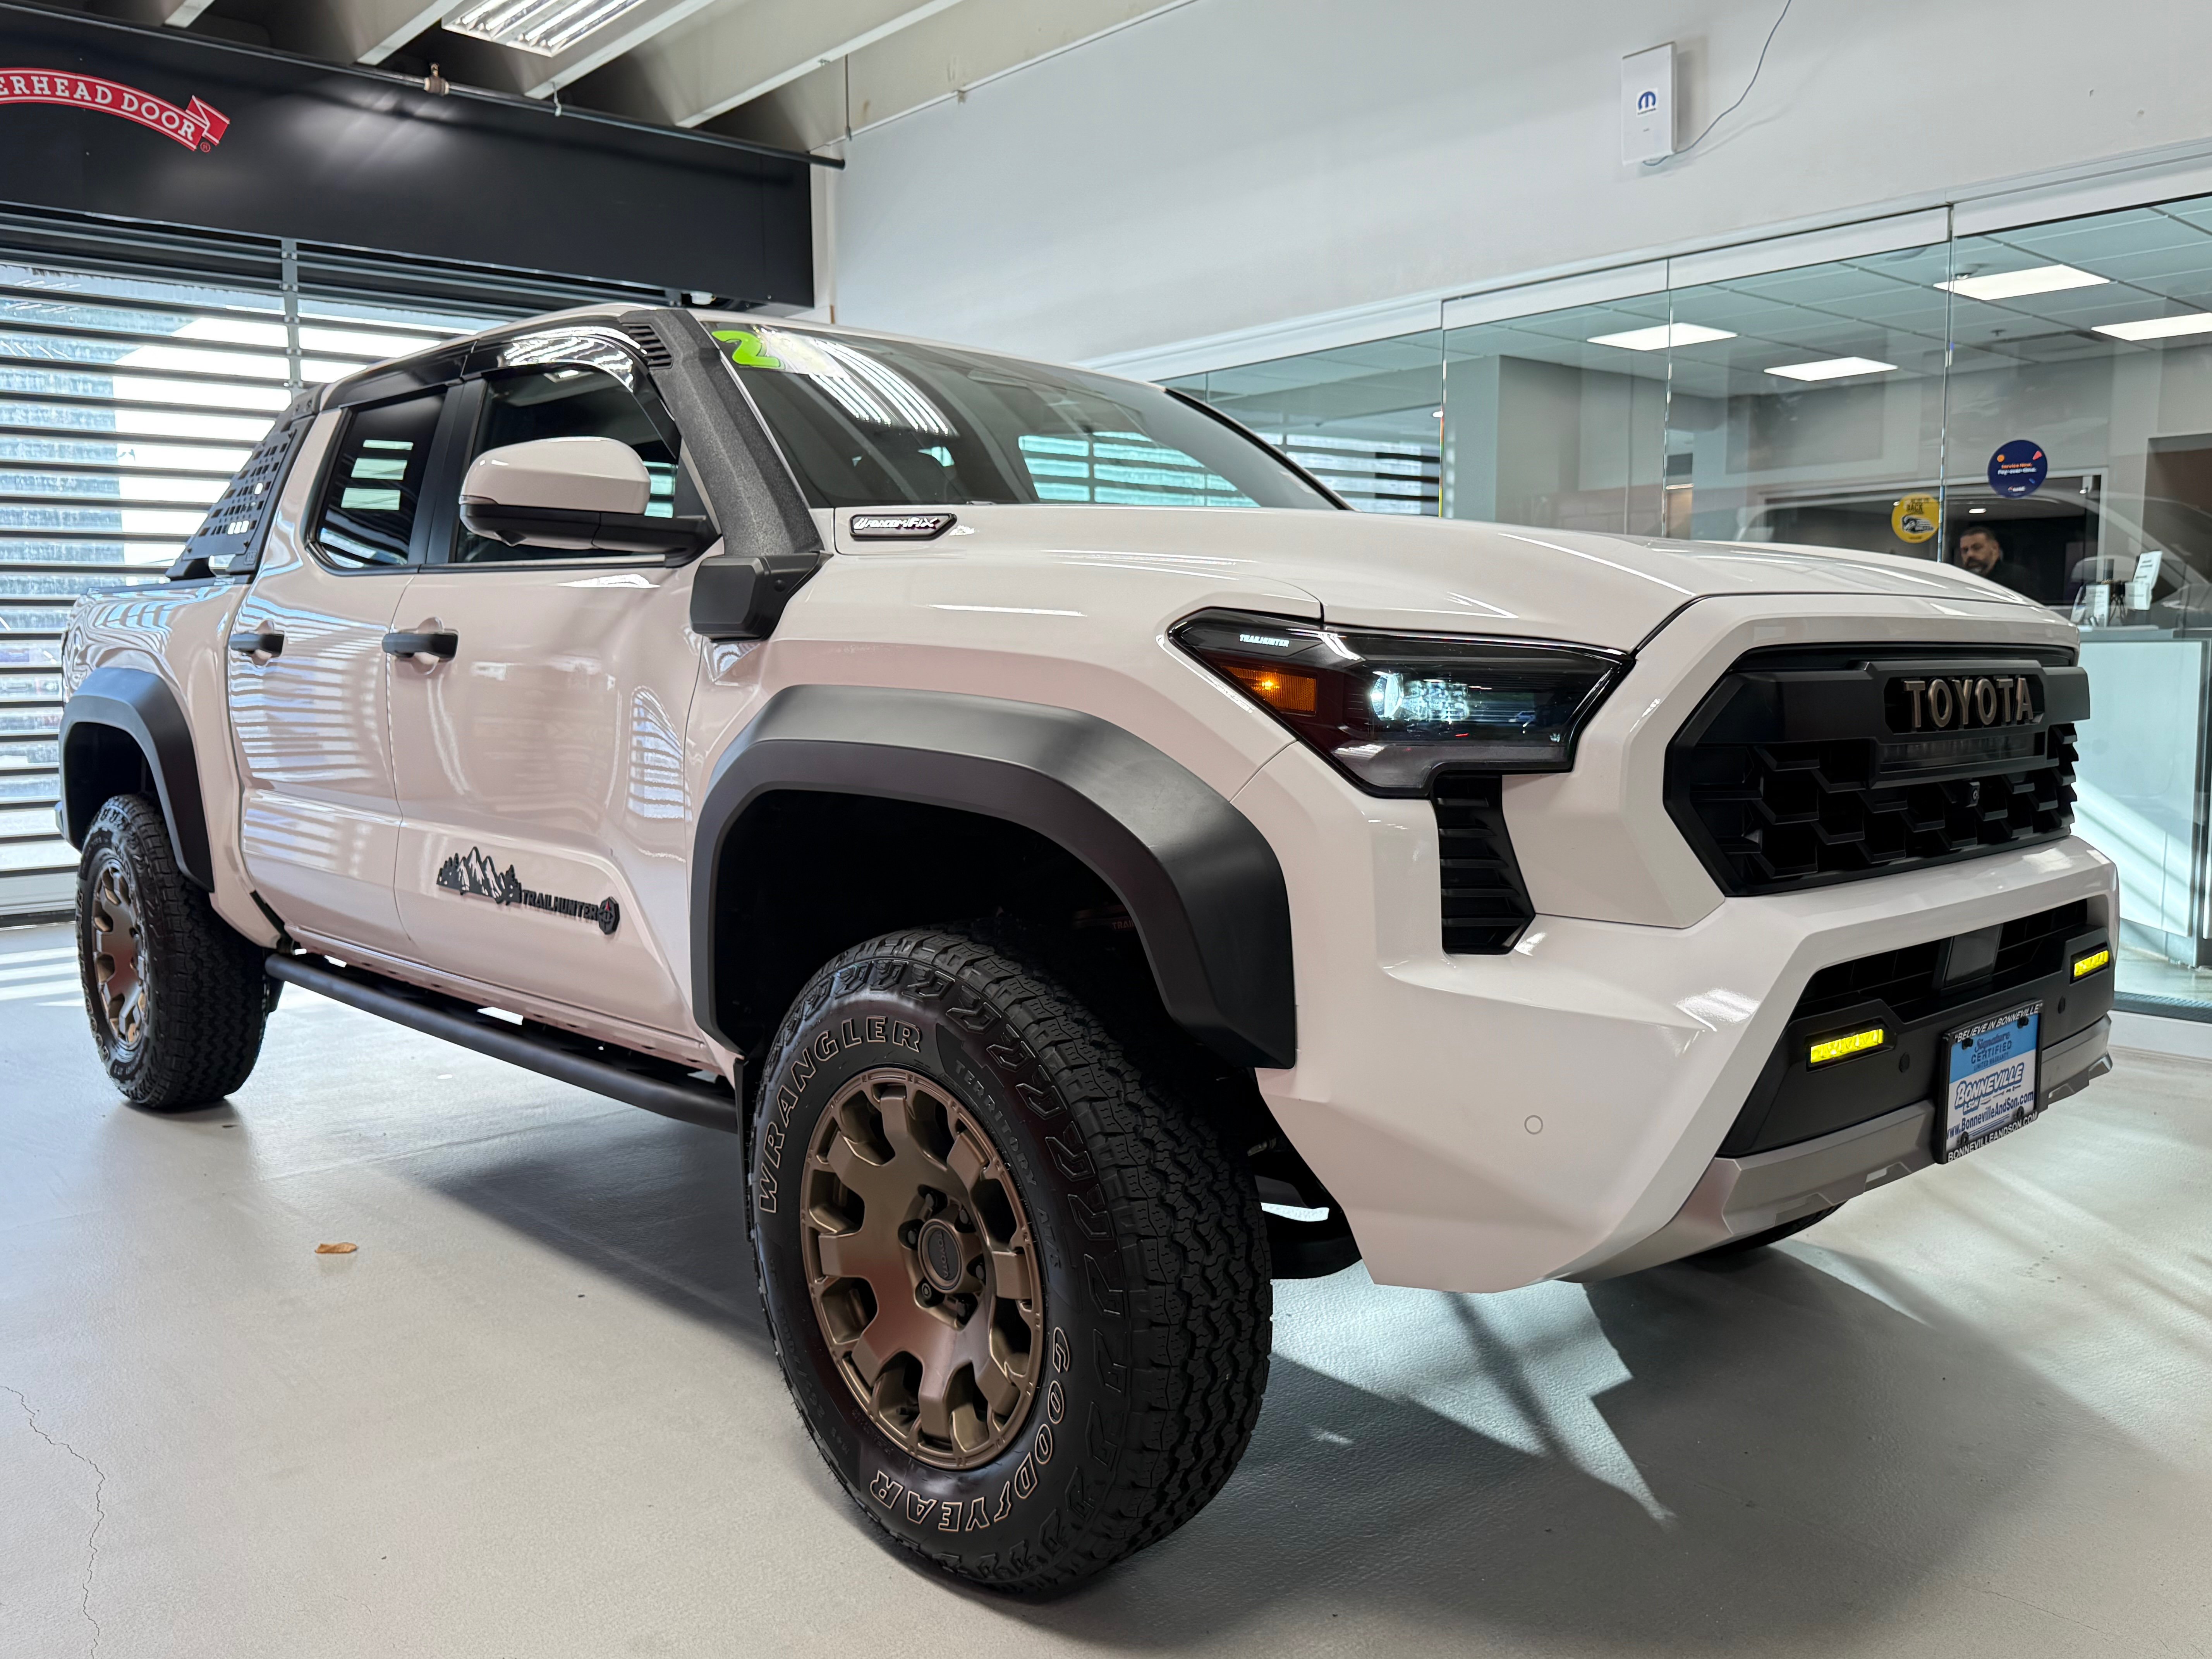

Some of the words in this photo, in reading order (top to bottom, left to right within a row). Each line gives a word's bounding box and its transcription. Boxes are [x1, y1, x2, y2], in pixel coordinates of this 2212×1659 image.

[121, 92, 195, 141] DOOR
[1240, 634, 1290, 647] TRAILHUNTER
[1903, 677, 2034, 728] TOYOTA
[522, 889, 599, 921] TRAILHUNTER
[1974, 1031, 2010, 1053] Signature
[1987, 1020, 1996, 1030] IN
[1971, 1040, 2013, 1064] CERTIFIED
[1954, 1061, 2025, 1109] BONNEVILLE
[759, 1015, 922, 1214] WRANGLER
[955, 1059, 1037, 1186] TERRITORY
[1948, 1111, 2038, 1162] BONNEVILLEANDSON.COM
[937, 1231, 949, 1278] TOYOTA
